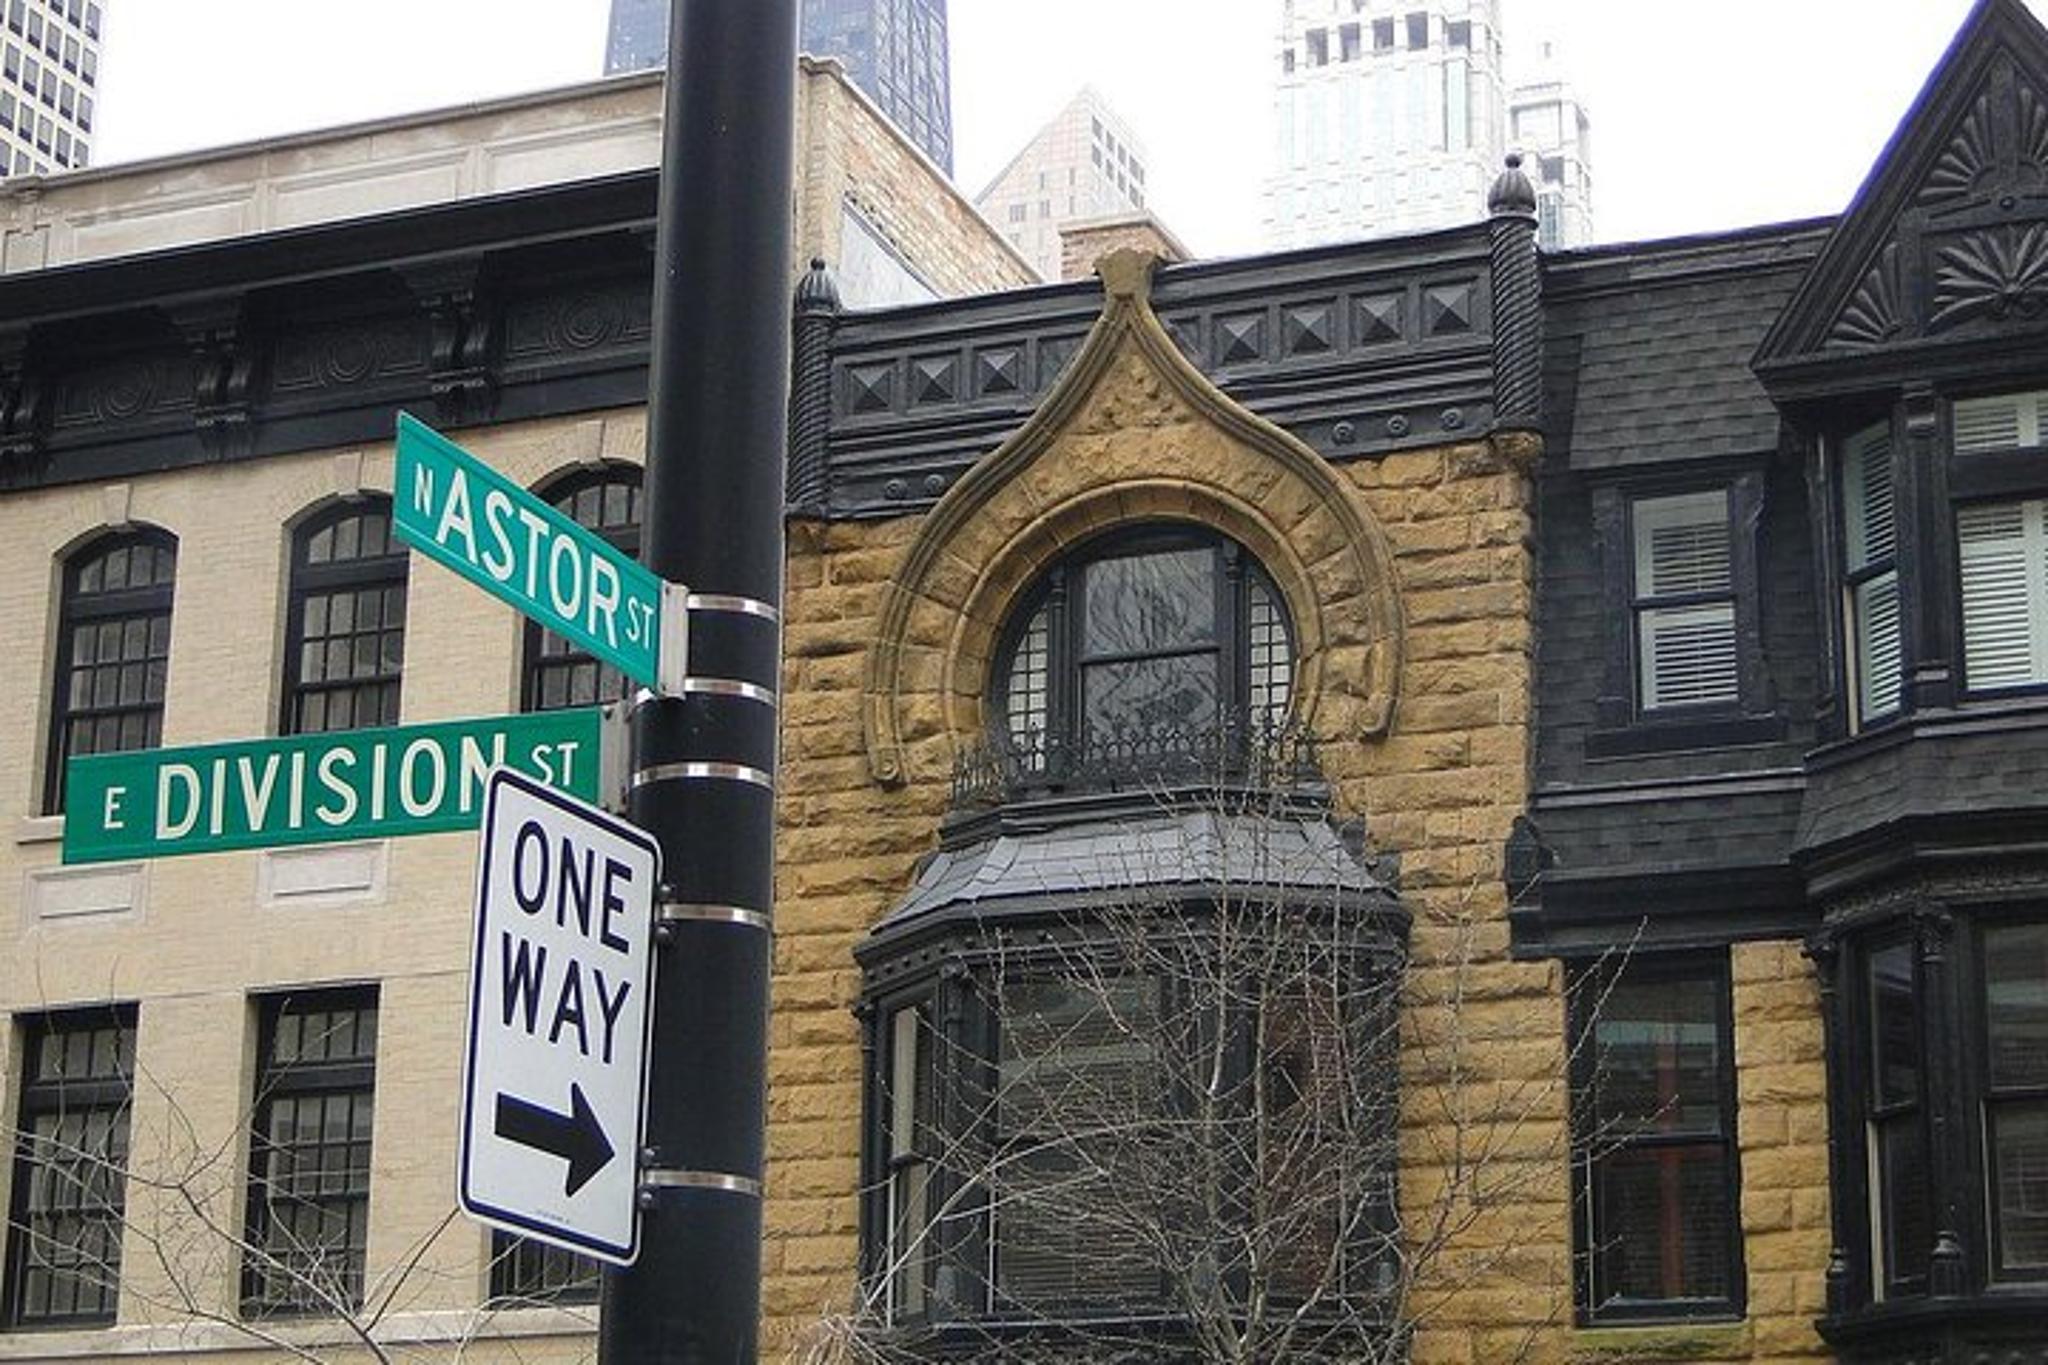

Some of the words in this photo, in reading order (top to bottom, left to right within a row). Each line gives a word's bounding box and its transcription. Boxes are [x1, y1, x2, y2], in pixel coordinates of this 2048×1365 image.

[413, 462, 433, 516] N
[435, 467, 621, 649] ASTOR
[625, 596, 655, 649] ST
[103, 786, 126, 830] E
[155, 733, 506, 840] DIVISION
[531, 741, 578, 787] ST
[513, 820, 633, 955] ONE
[501, 932, 631, 1065] WAY
